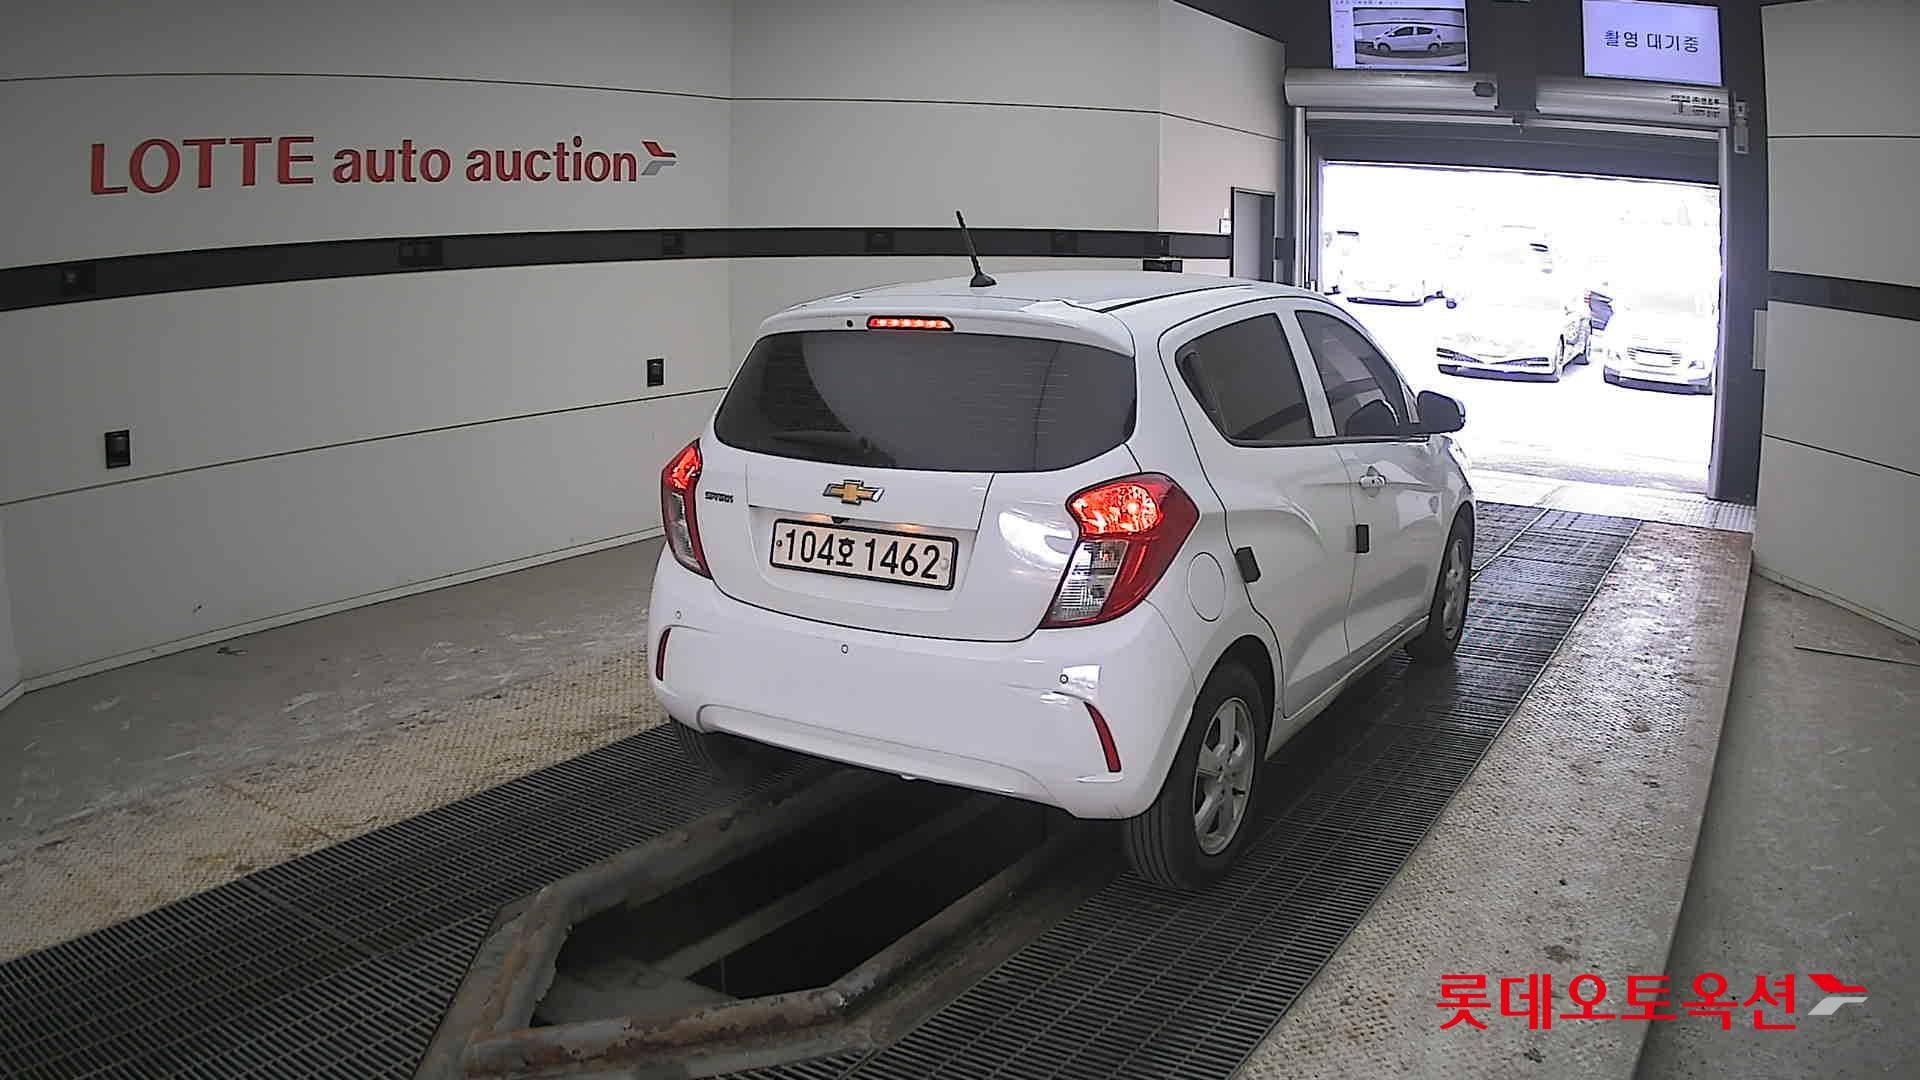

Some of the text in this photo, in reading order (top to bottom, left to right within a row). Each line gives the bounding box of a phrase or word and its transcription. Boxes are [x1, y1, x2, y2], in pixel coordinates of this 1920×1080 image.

[1603, 29, 1700, 54] 촬영 대기중
[91, 135, 638, 195] LOTTE auto auction
[785, 528, 941, 580] 104호 1462
